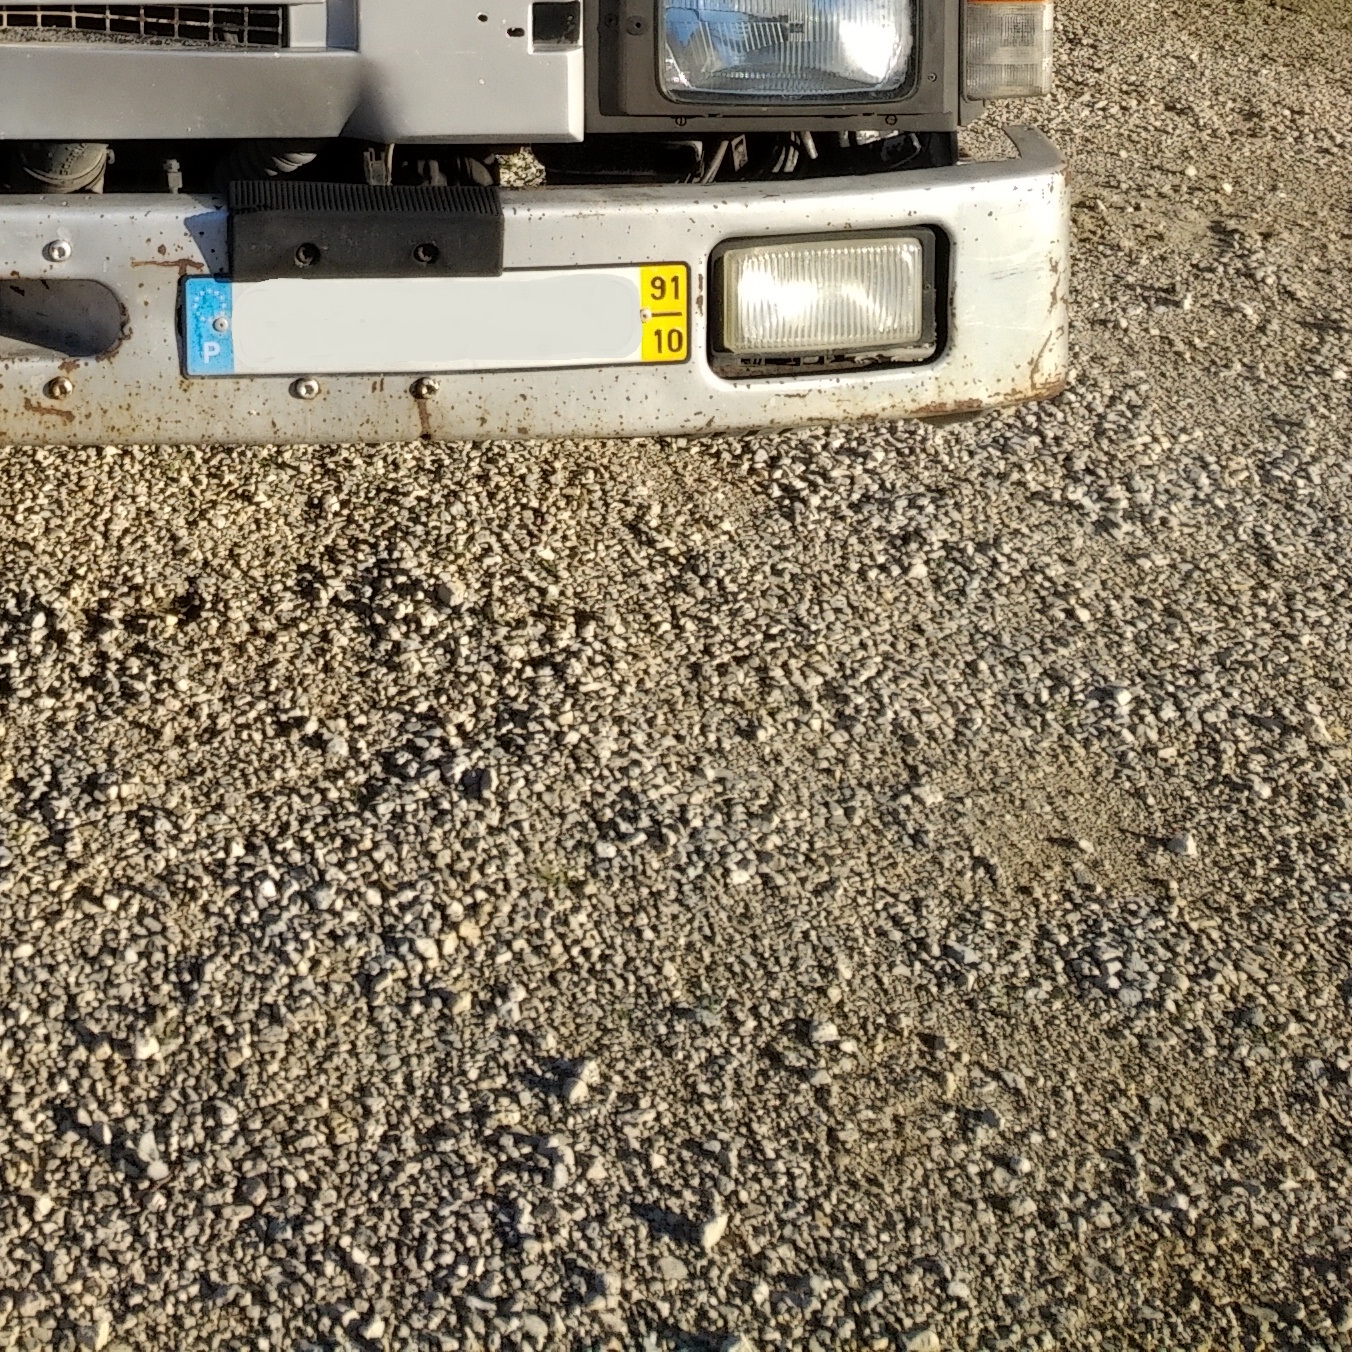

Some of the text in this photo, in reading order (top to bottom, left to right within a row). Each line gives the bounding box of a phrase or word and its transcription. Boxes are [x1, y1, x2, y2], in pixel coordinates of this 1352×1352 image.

[650, 275, 680, 300] 91
[204, 341, 221, 364] P
[654, 328, 683, 354] 10
